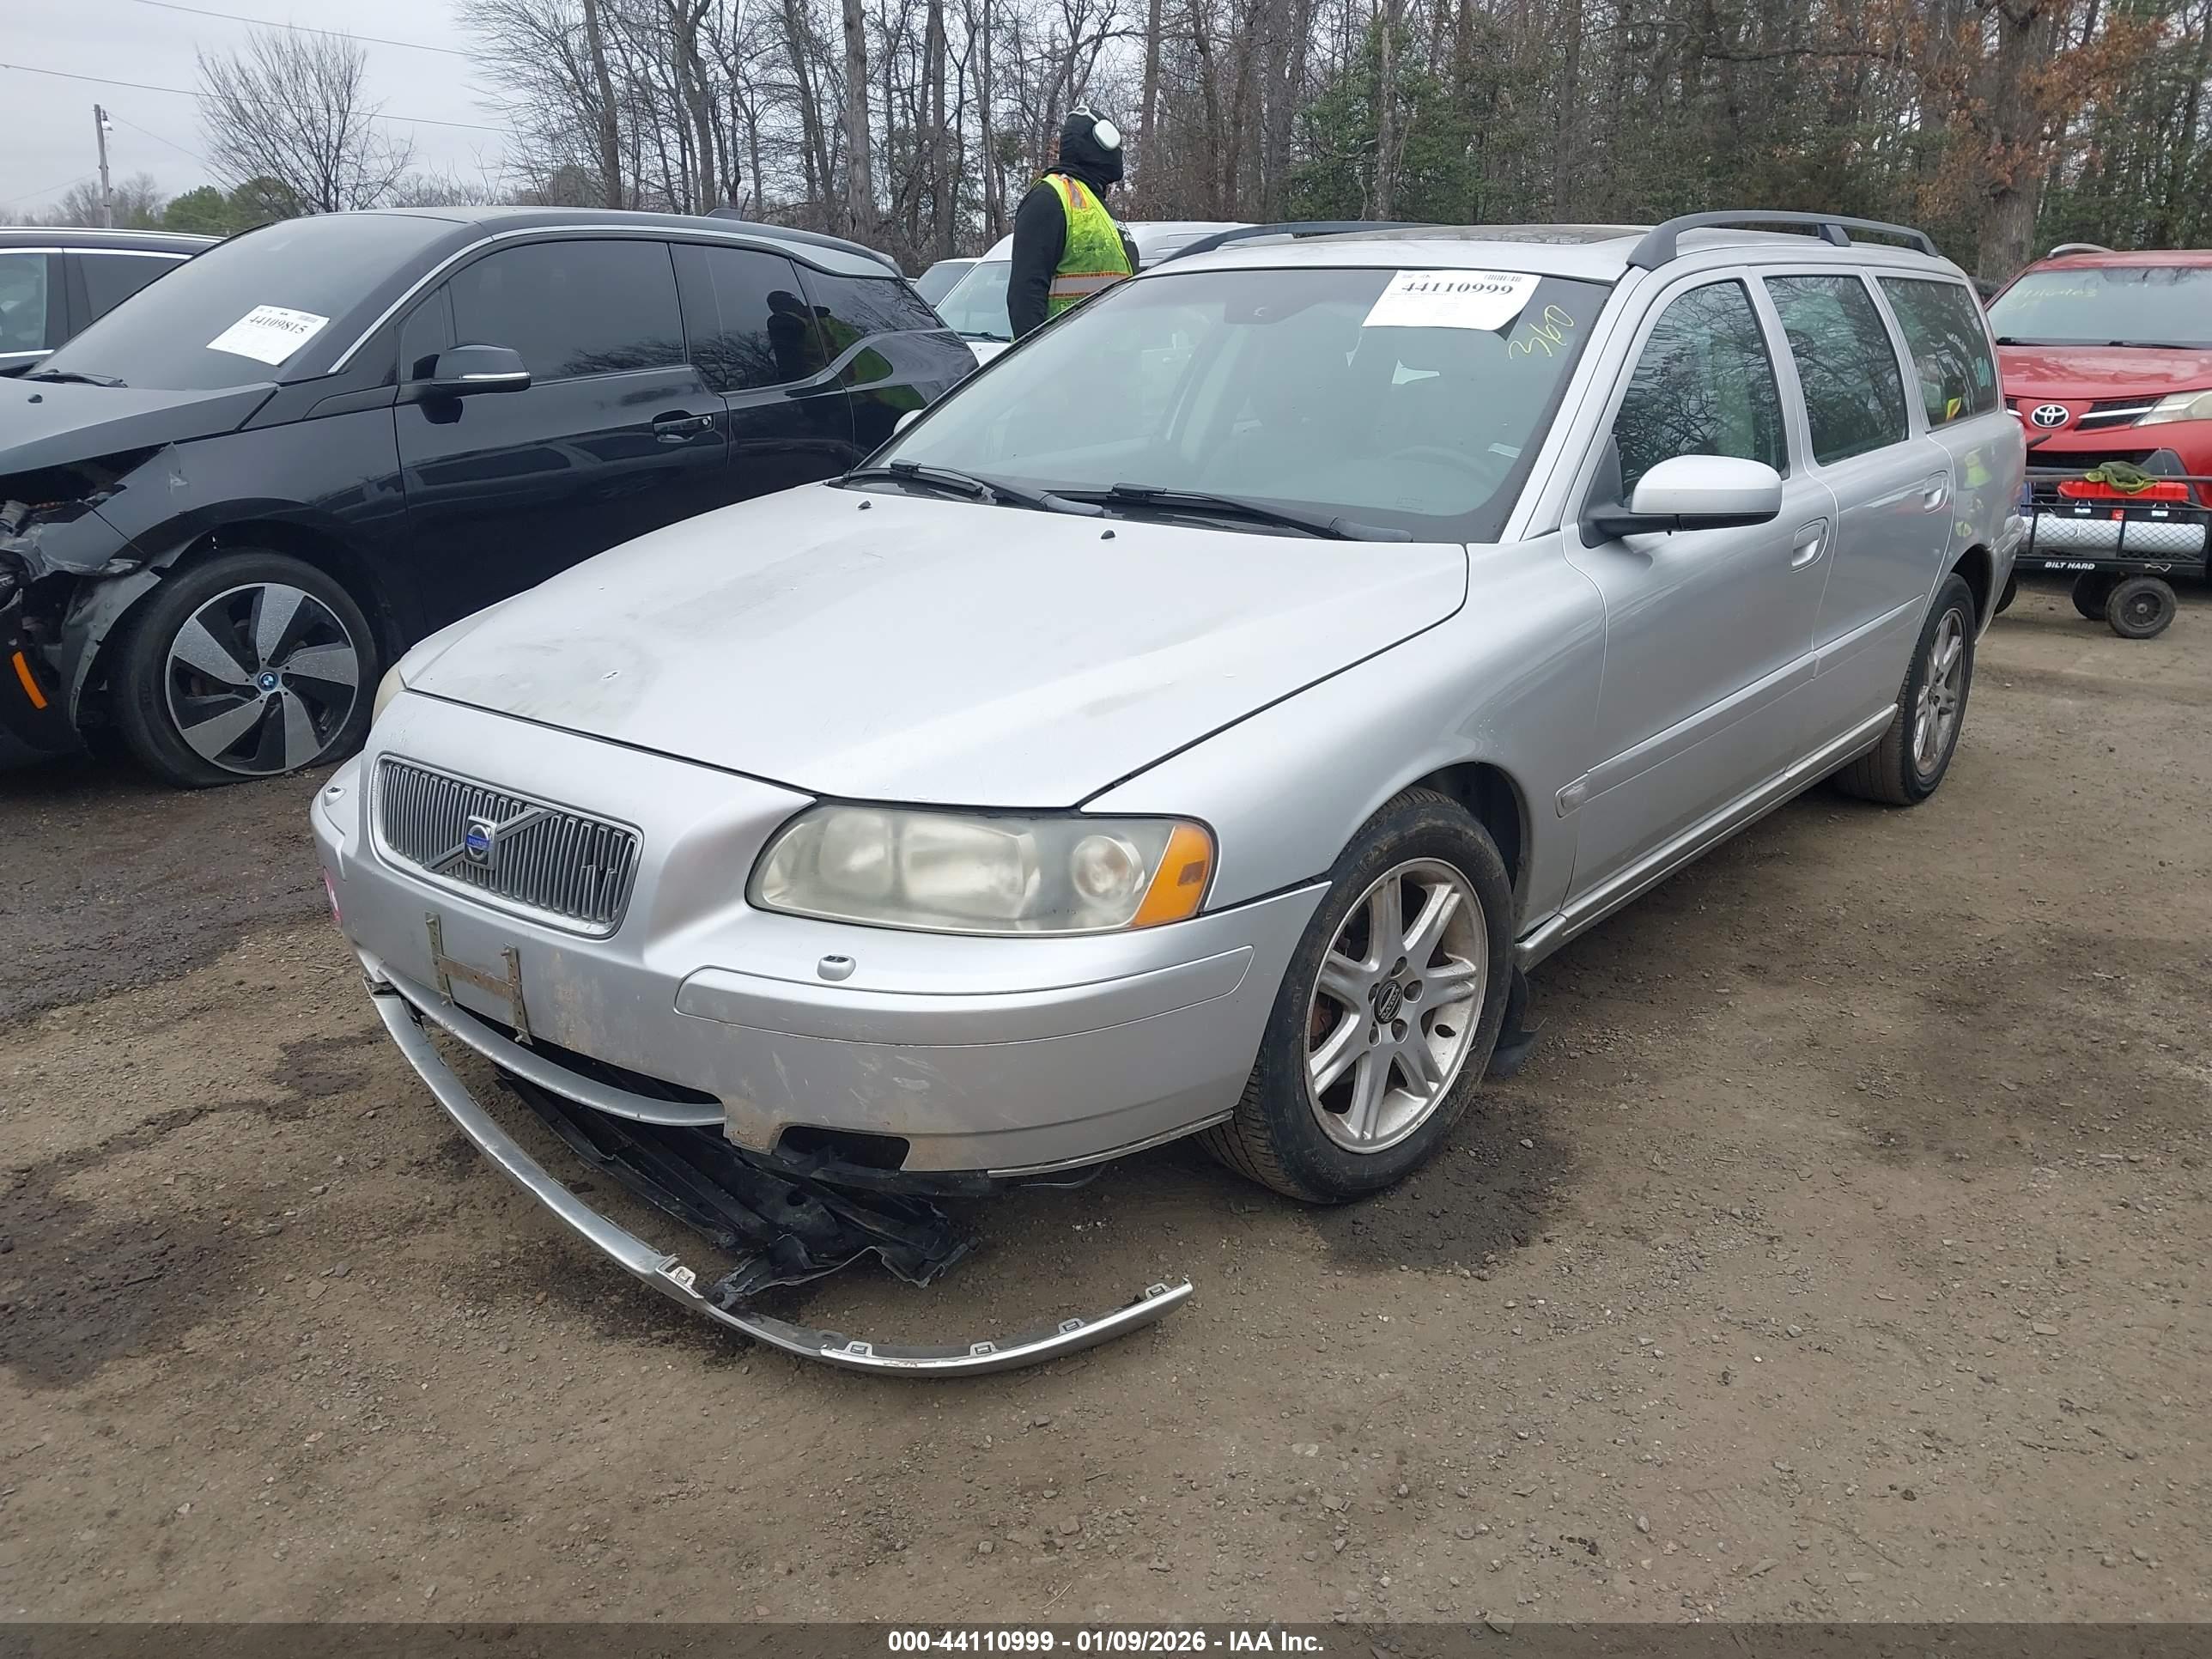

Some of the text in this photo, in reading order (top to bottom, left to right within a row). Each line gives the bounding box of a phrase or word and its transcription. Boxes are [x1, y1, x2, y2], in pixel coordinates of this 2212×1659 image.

[1401, 282, 1514, 295] 44110999
[249, 315, 308, 334] 44109815
[2067, 562, 2096, 570] HARD
